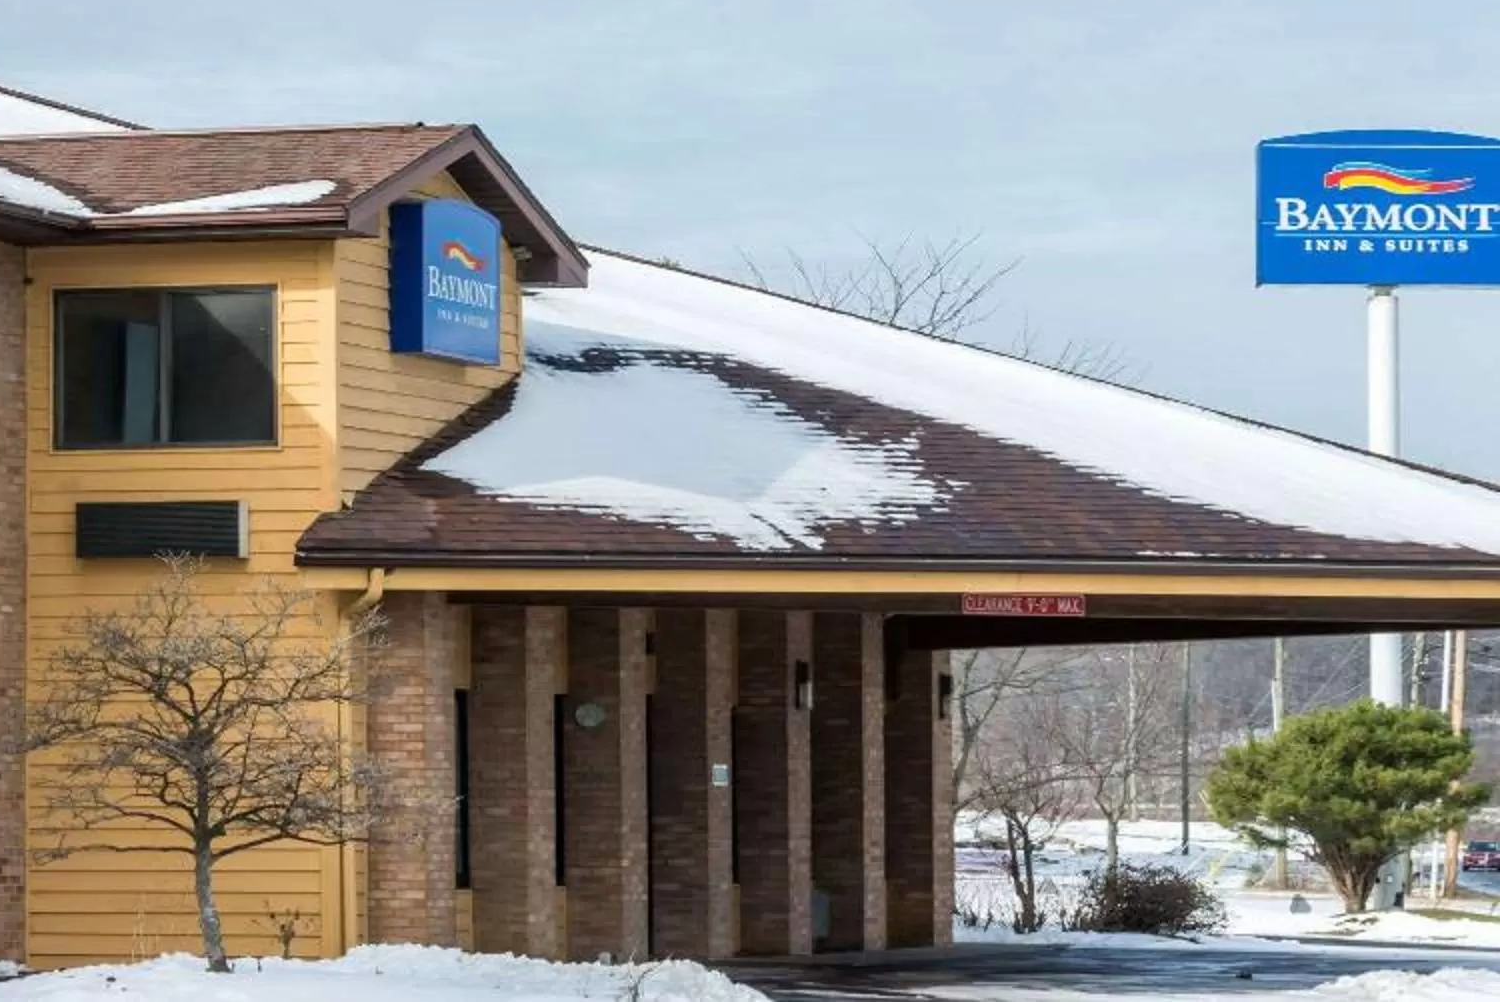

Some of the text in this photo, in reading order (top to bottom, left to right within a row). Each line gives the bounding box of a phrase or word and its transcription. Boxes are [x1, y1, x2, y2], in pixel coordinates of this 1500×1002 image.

[1275, 197, 1500, 231] BAYMONT
[1304, 239, 1469, 252] INN & SUITES
[427, 265, 497, 310] BAYMONT
[965, 596, 1023, 612] CLEARANCE
